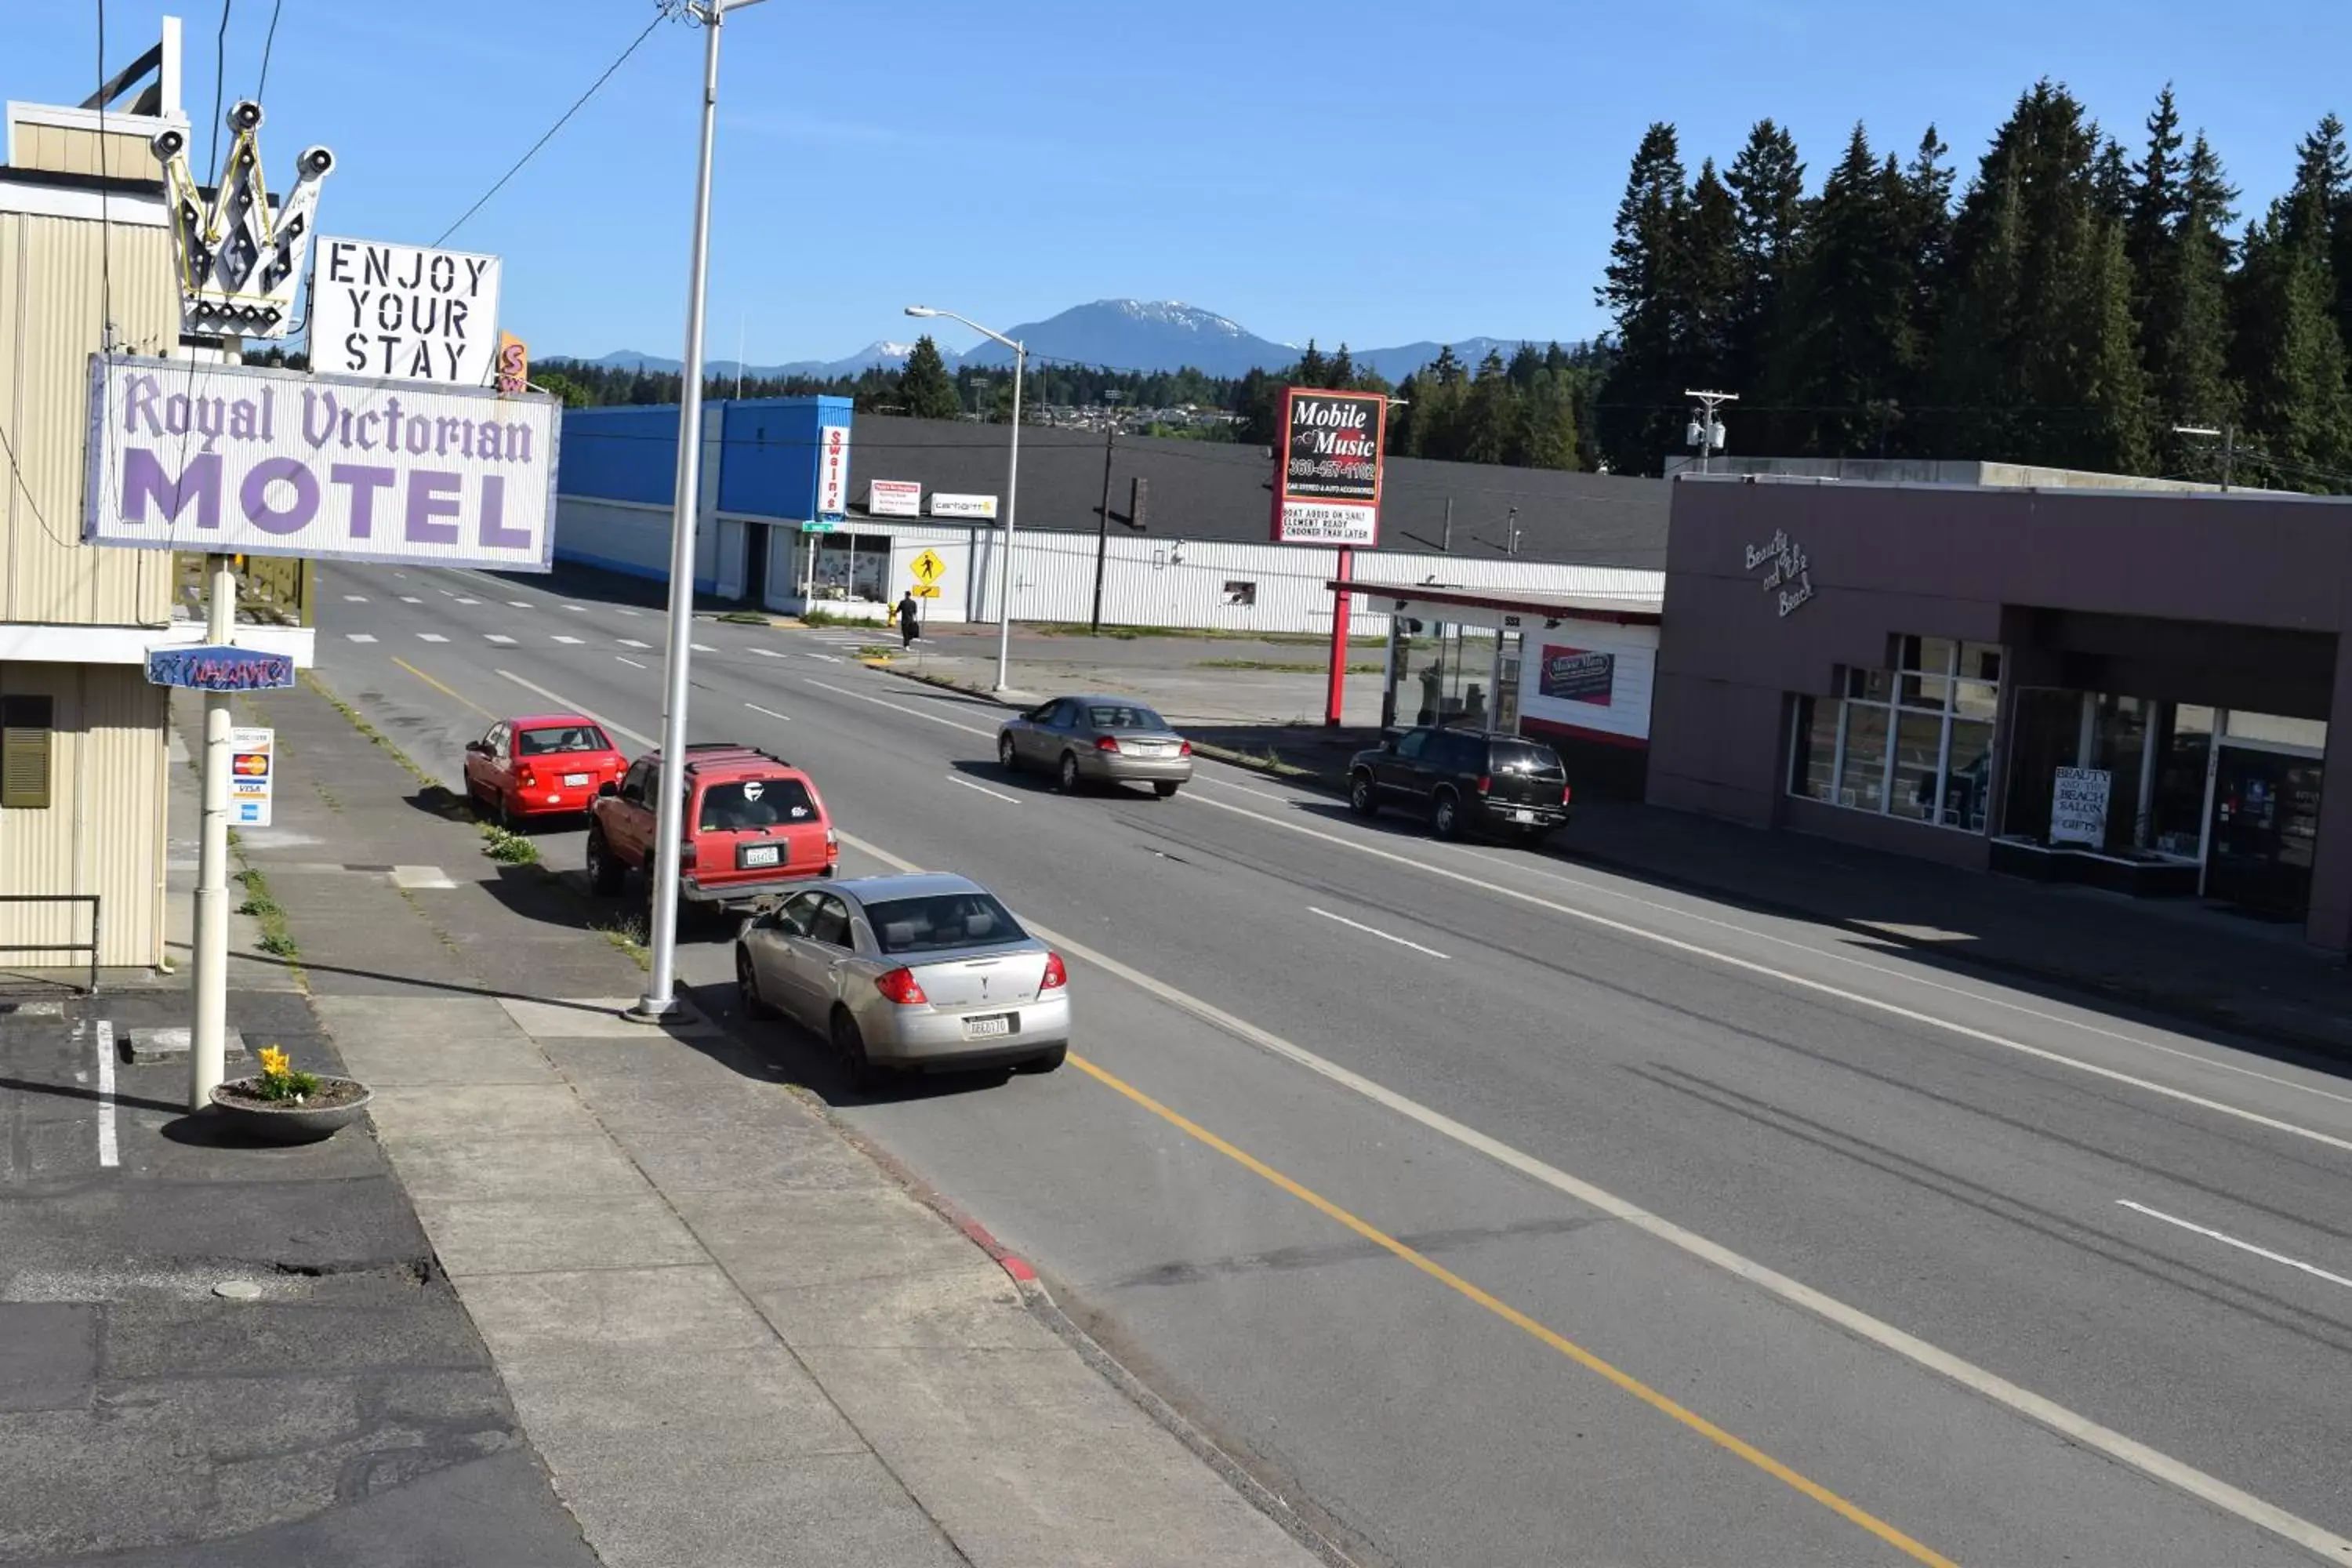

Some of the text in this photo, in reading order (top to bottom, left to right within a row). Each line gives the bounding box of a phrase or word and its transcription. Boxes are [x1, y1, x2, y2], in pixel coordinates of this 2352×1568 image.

[330, 242, 487, 297] ENJOY
[347, 289, 468, 339] YOUR
[345, 332, 466, 381] STAY
[123, 372, 532, 464] Royal Victorian
[1293, 401, 1367, 428] Mobile
[1314, 430, 1374, 457] Music
[122, 447, 532, 549] MOTEL
[935, 499, 985, 512] carhartt
[1323, 519, 1348, 528] READY
[1345, 530, 1367, 539] LATER
[1746, 528, 1790, 569] Beauty
[1764, 543, 1807, 591] and the
[1779, 572, 1813, 617] Beach
[2056, 768, 2109, 782] BEAUTY
